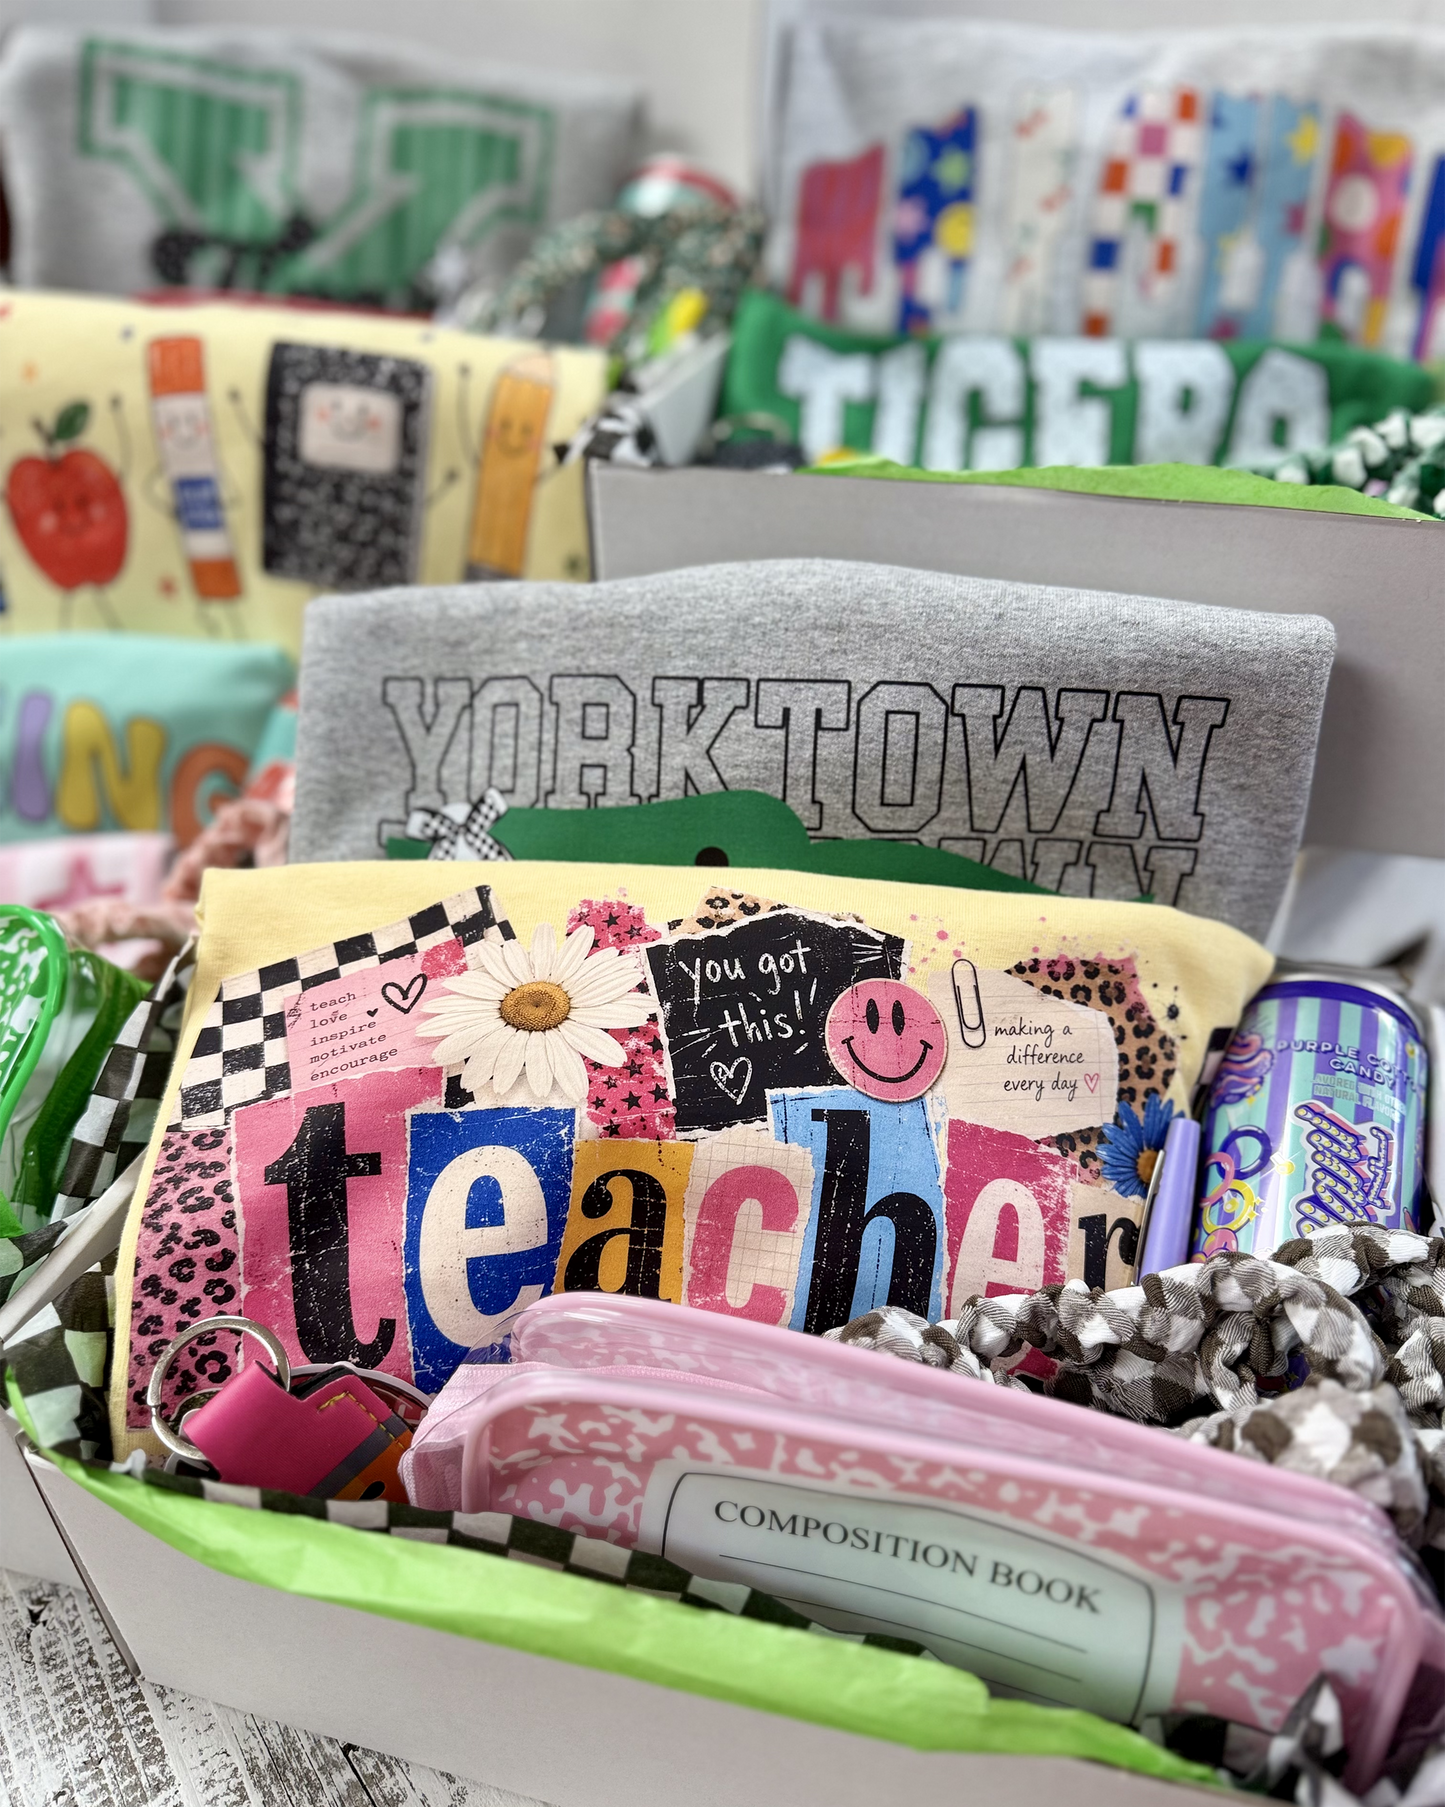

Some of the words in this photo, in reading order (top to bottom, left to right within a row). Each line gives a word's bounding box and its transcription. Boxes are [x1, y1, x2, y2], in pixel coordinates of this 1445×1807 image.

[0, 690, 249, 852] ING
[382, 674, 1231, 841] YORKTOWN
[678, 957, 746, 1005] you
[758, 939, 811, 996] got
[310, 992, 357, 1012] teach
[310, 1013, 348, 1029] love
[310, 1021, 377, 1047] inspire
[994, 1016, 1055, 1048] making
[1062, 1025, 1073, 1036] a
[310, 1034, 387, 1064] motivate
[310, 1048, 398, 1081] encourage
[1006, 1044, 1085, 1065] difference
[1276, 1039, 1360, 1060] PURPLE
[1366, 1053, 1418, 1093] COTTO
[1329, 1058, 1396, 1091] CANDY
[1003, 1079, 1045, 1102] every
[1051, 1071, 1078, 1102] day
[265, 1104, 1141, 1365] teacher
[714, 1499, 980, 1578] COMPOSITION
[988, 1560, 1105, 1615] BOOK
